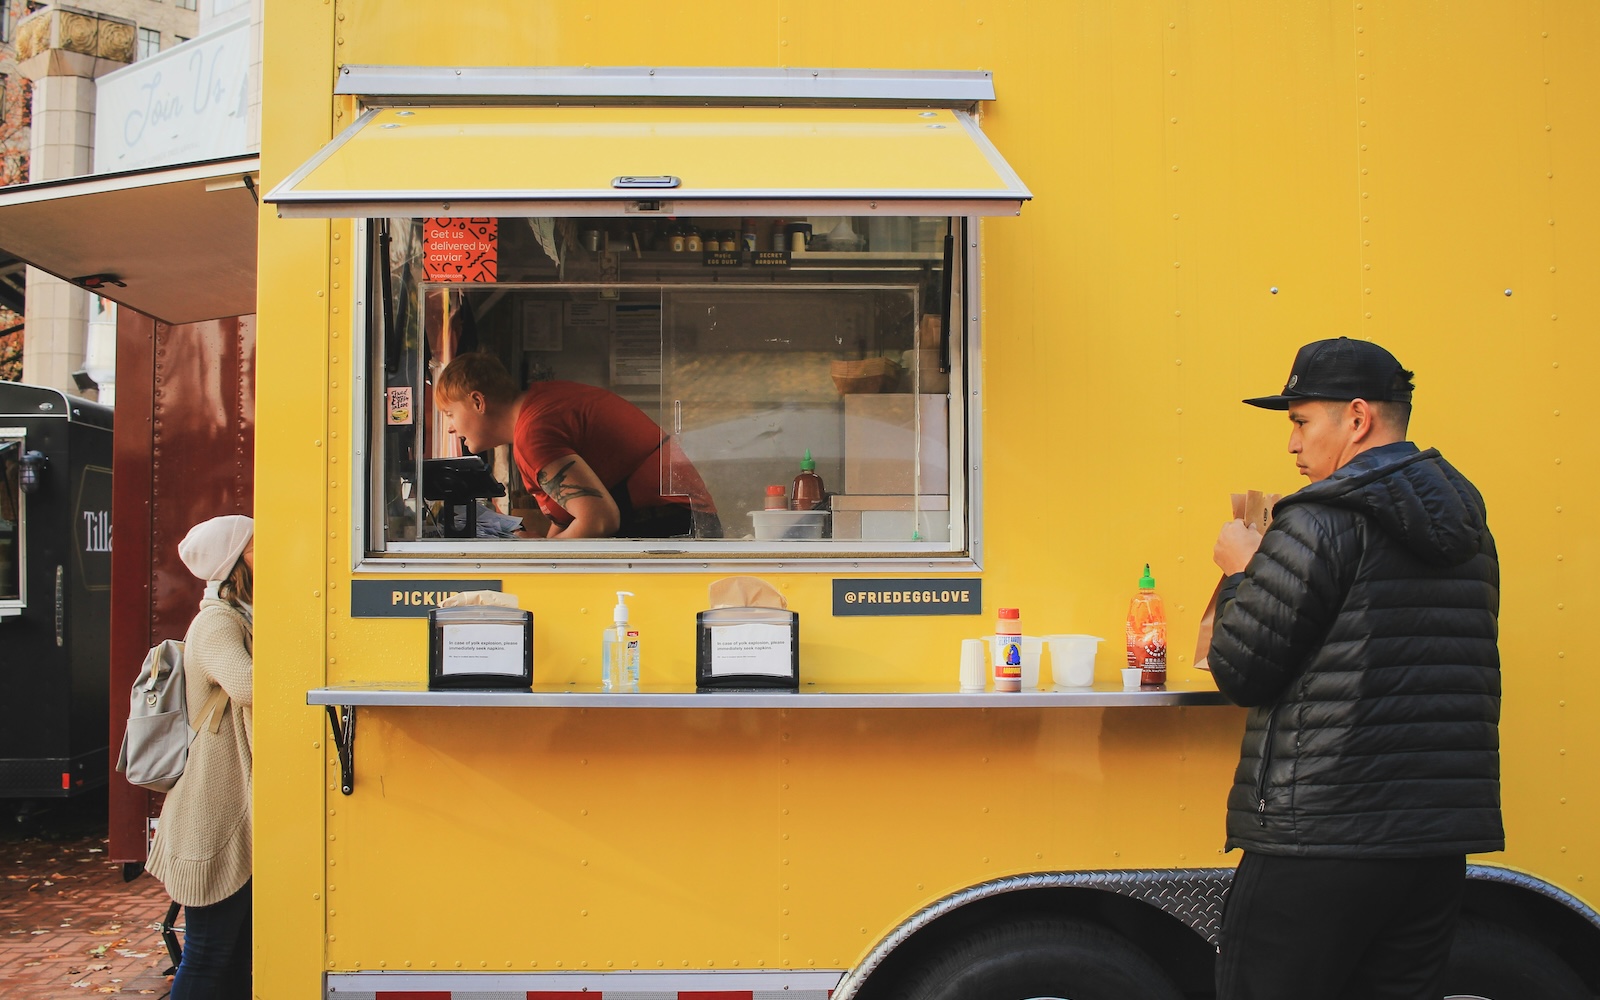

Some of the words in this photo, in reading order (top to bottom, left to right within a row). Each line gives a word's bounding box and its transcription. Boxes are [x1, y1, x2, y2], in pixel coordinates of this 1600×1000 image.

[124, 71, 183, 148] Join
[189, 44, 226, 115] Us
[430, 229, 450, 239] Get
[452, 231, 464, 239] us
[430, 241, 476, 251] delivered
[478, 241, 491, 253] by
[430, 252, 463, 262] caviar
[844, 590, 970, 604] @FRIEDEGGLOVE
